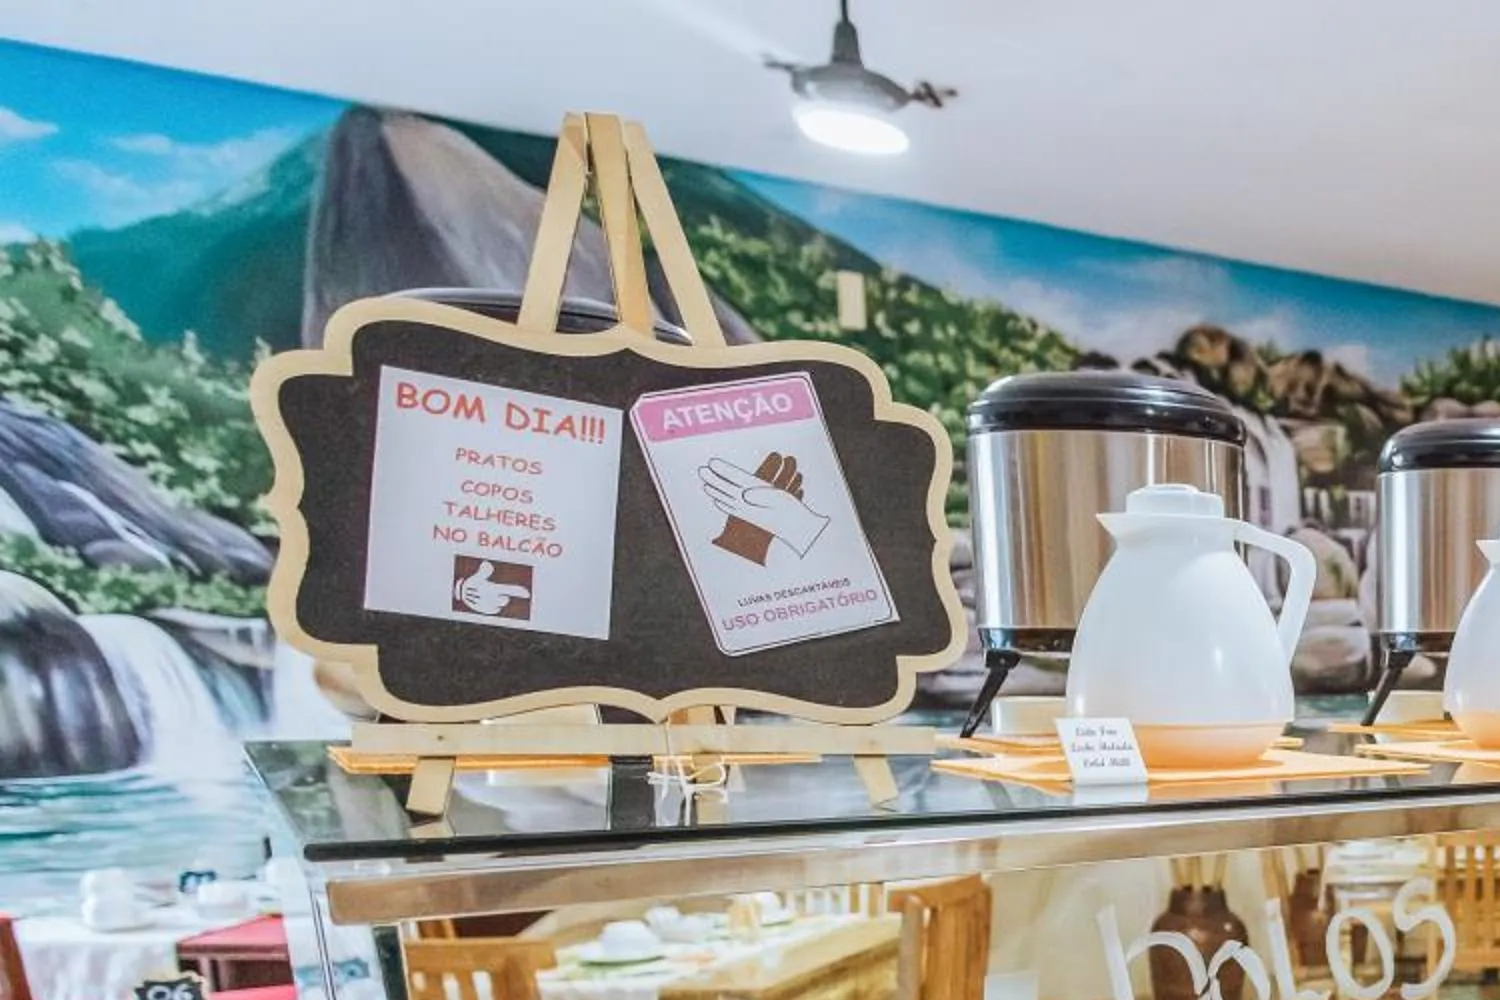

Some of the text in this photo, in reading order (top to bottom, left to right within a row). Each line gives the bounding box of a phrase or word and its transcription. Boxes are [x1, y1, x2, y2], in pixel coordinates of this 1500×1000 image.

[395, 381, 606, 444] BOM DIA!!!
[662, 391, 794, 432] ATENÇÃO
[455, 447, 544, 475] PRATOS
[460, 479, 534, 504] COPOS
[443, 500, 557, 531] TALHERES
[432, 524, 563, 558] NO BALCÃO
[722, 588, 878, 631] USO OBRIGATÓRIO
[737, 594, 772, 607] LUVAS
